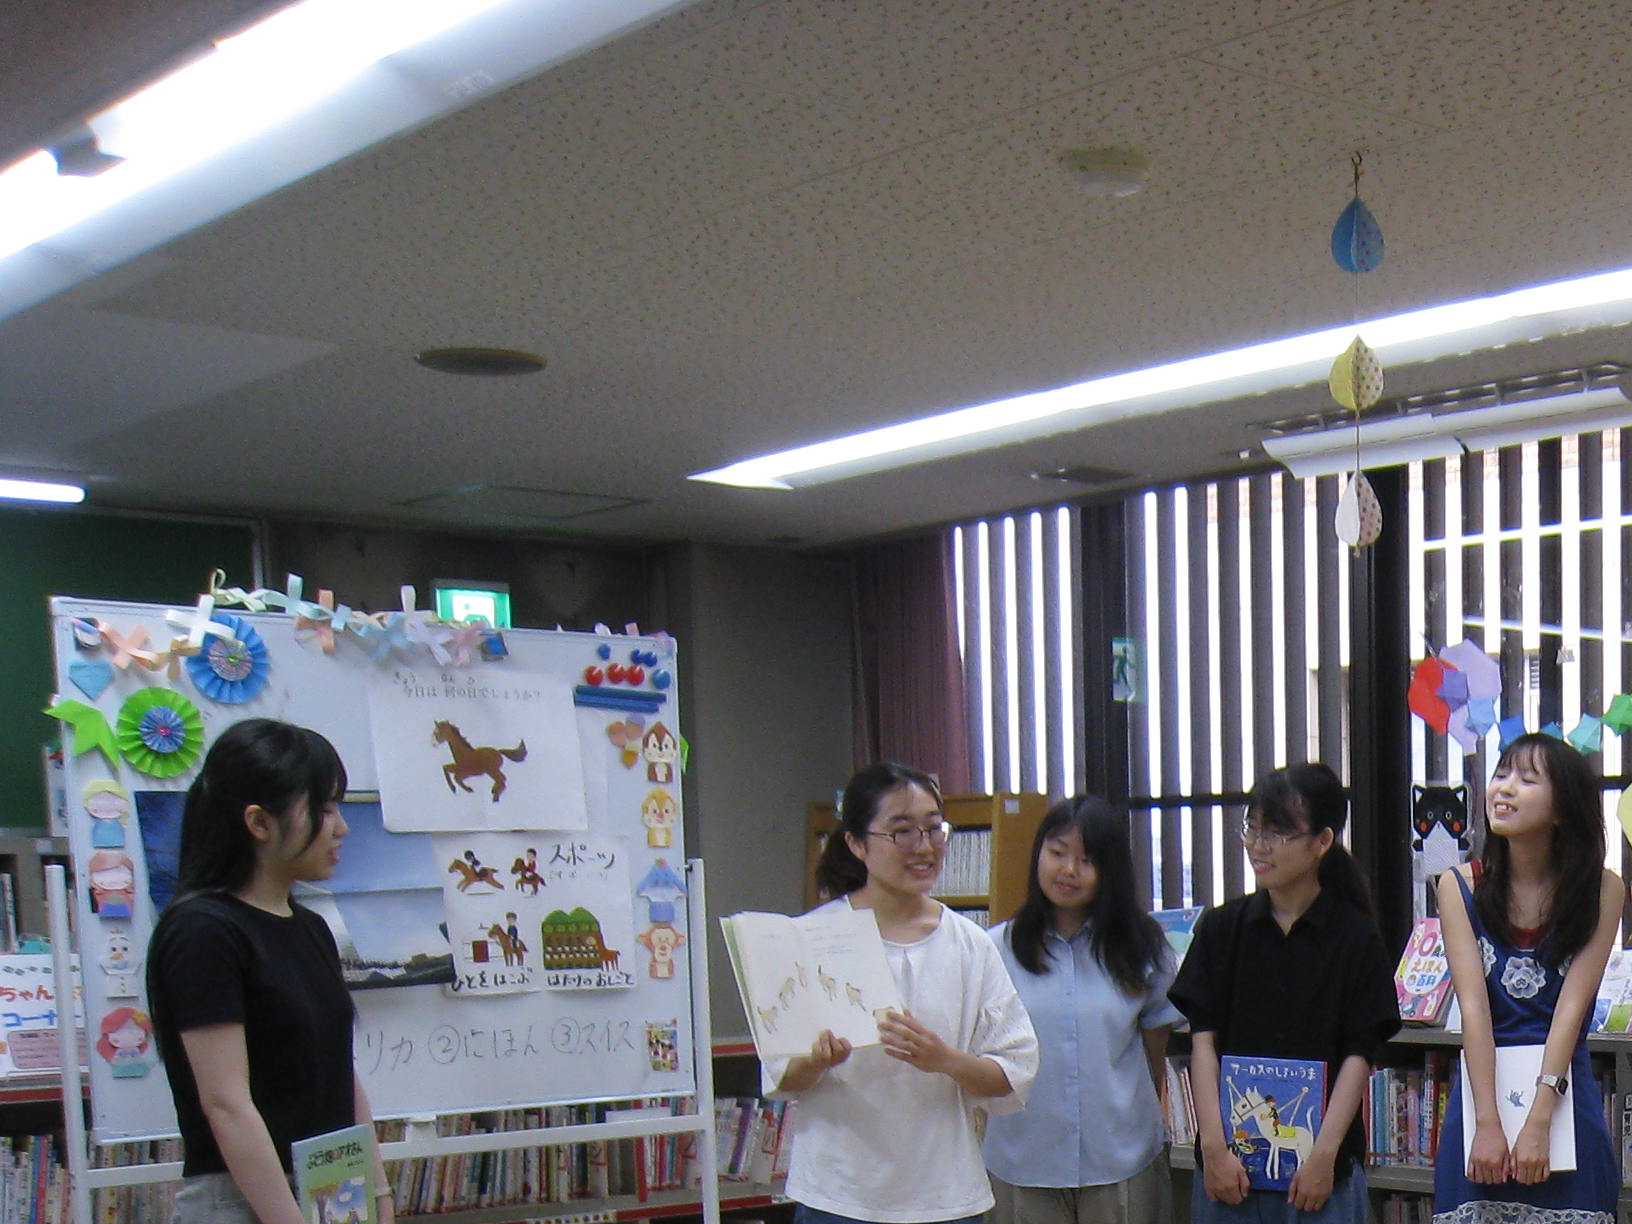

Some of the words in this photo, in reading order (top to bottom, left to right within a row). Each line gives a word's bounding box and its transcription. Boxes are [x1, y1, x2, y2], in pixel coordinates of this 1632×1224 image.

[550, 842, 615, 869] スポーツ
[354, 1030, 413, 1075] リカ
